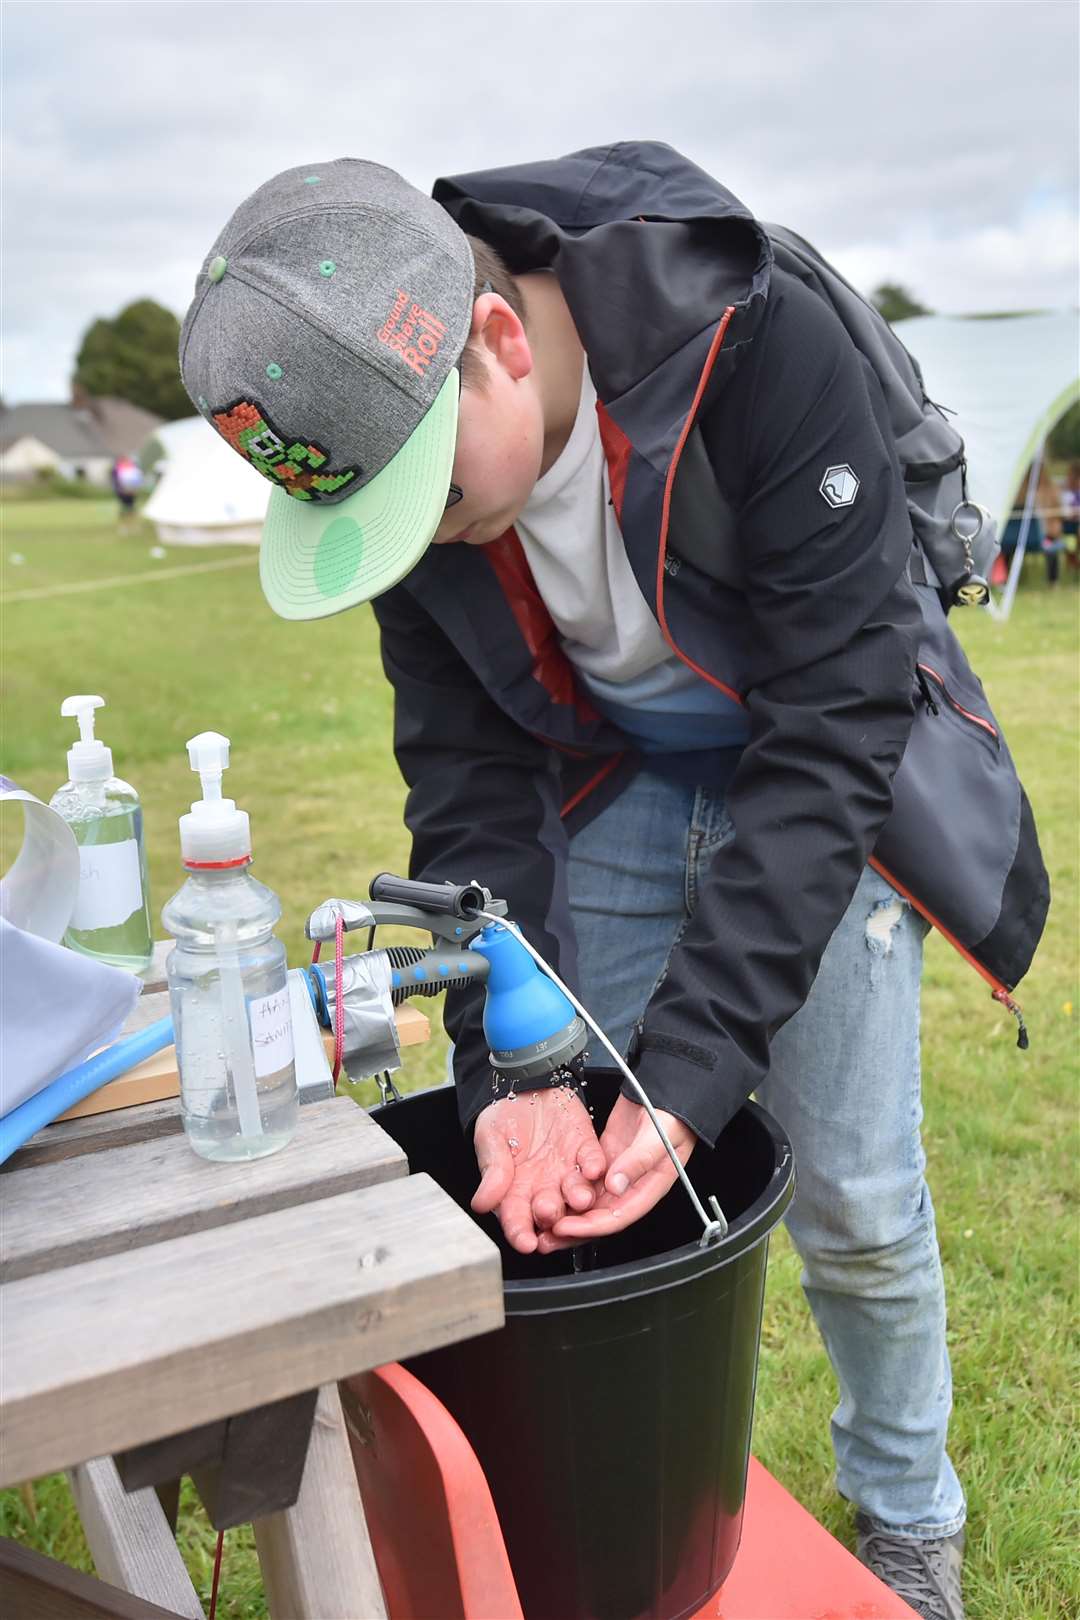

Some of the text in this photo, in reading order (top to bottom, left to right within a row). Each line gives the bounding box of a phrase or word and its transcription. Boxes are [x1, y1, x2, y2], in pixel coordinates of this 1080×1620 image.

[377, 287, 411, 342] Ground
[400, 310, 449, 375] Roll
[80, 863, 100, 881] sh
